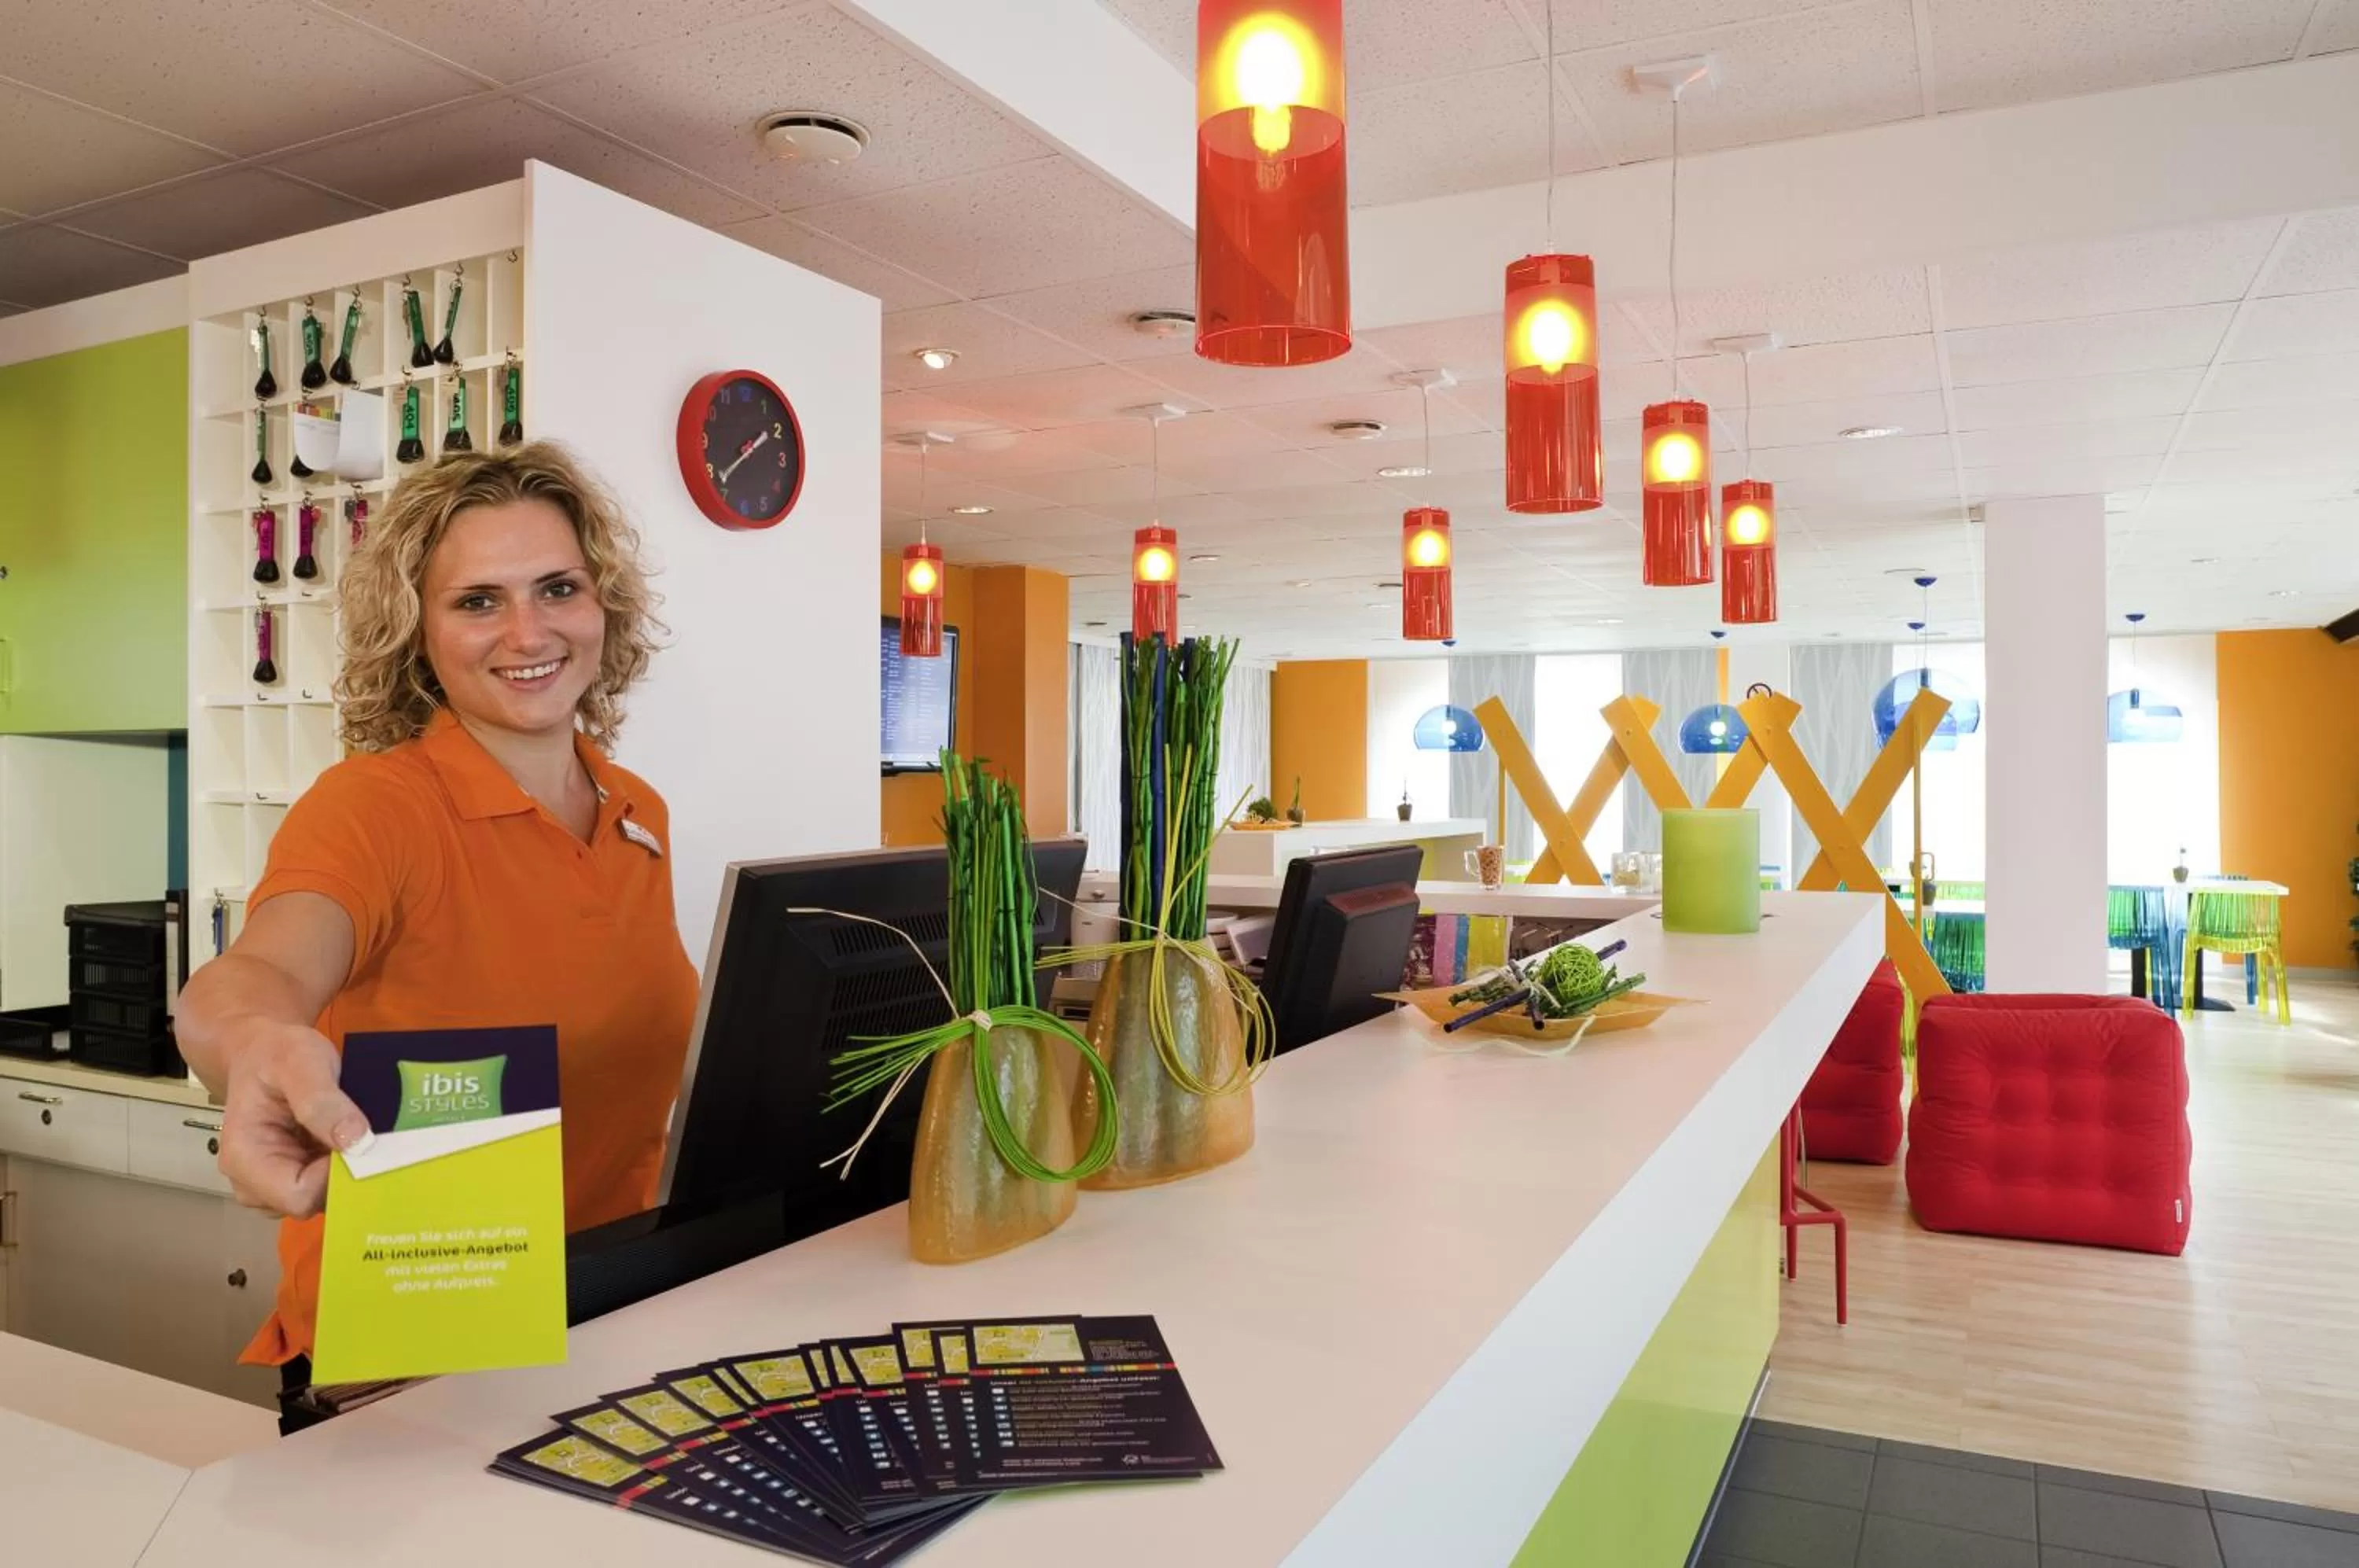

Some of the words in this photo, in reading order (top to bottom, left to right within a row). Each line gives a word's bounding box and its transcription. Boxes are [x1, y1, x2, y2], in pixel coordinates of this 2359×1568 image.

[773, 422, 782, 439] 2
[778, 452, 786, 468] 3
[759, 496, 768, 512] 5
[422, 1072, 480, 1096] ibis
